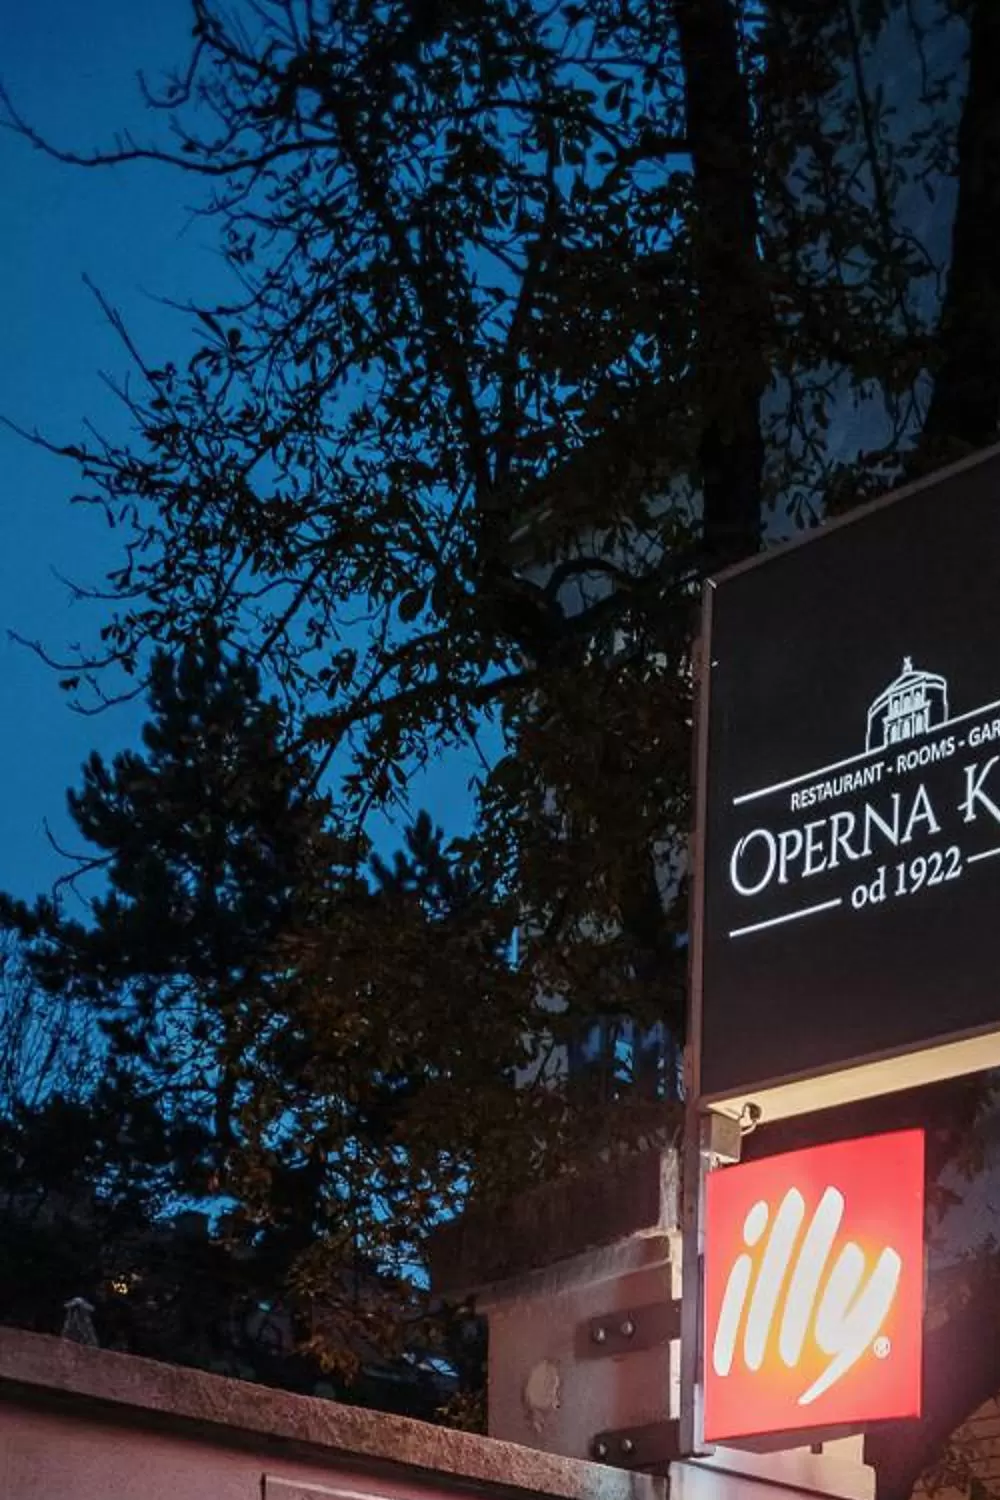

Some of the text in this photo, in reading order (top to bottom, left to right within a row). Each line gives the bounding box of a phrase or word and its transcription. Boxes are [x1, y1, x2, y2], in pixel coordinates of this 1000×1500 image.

[790, 763, 884, 811] RESTAURANT
[897, 736, 955, 774] ROOMS
[729, 783, 941, 896] OPERNA
[851, 845, 963, 909] od 1922
[713, 1186, 901, 1405] illy
